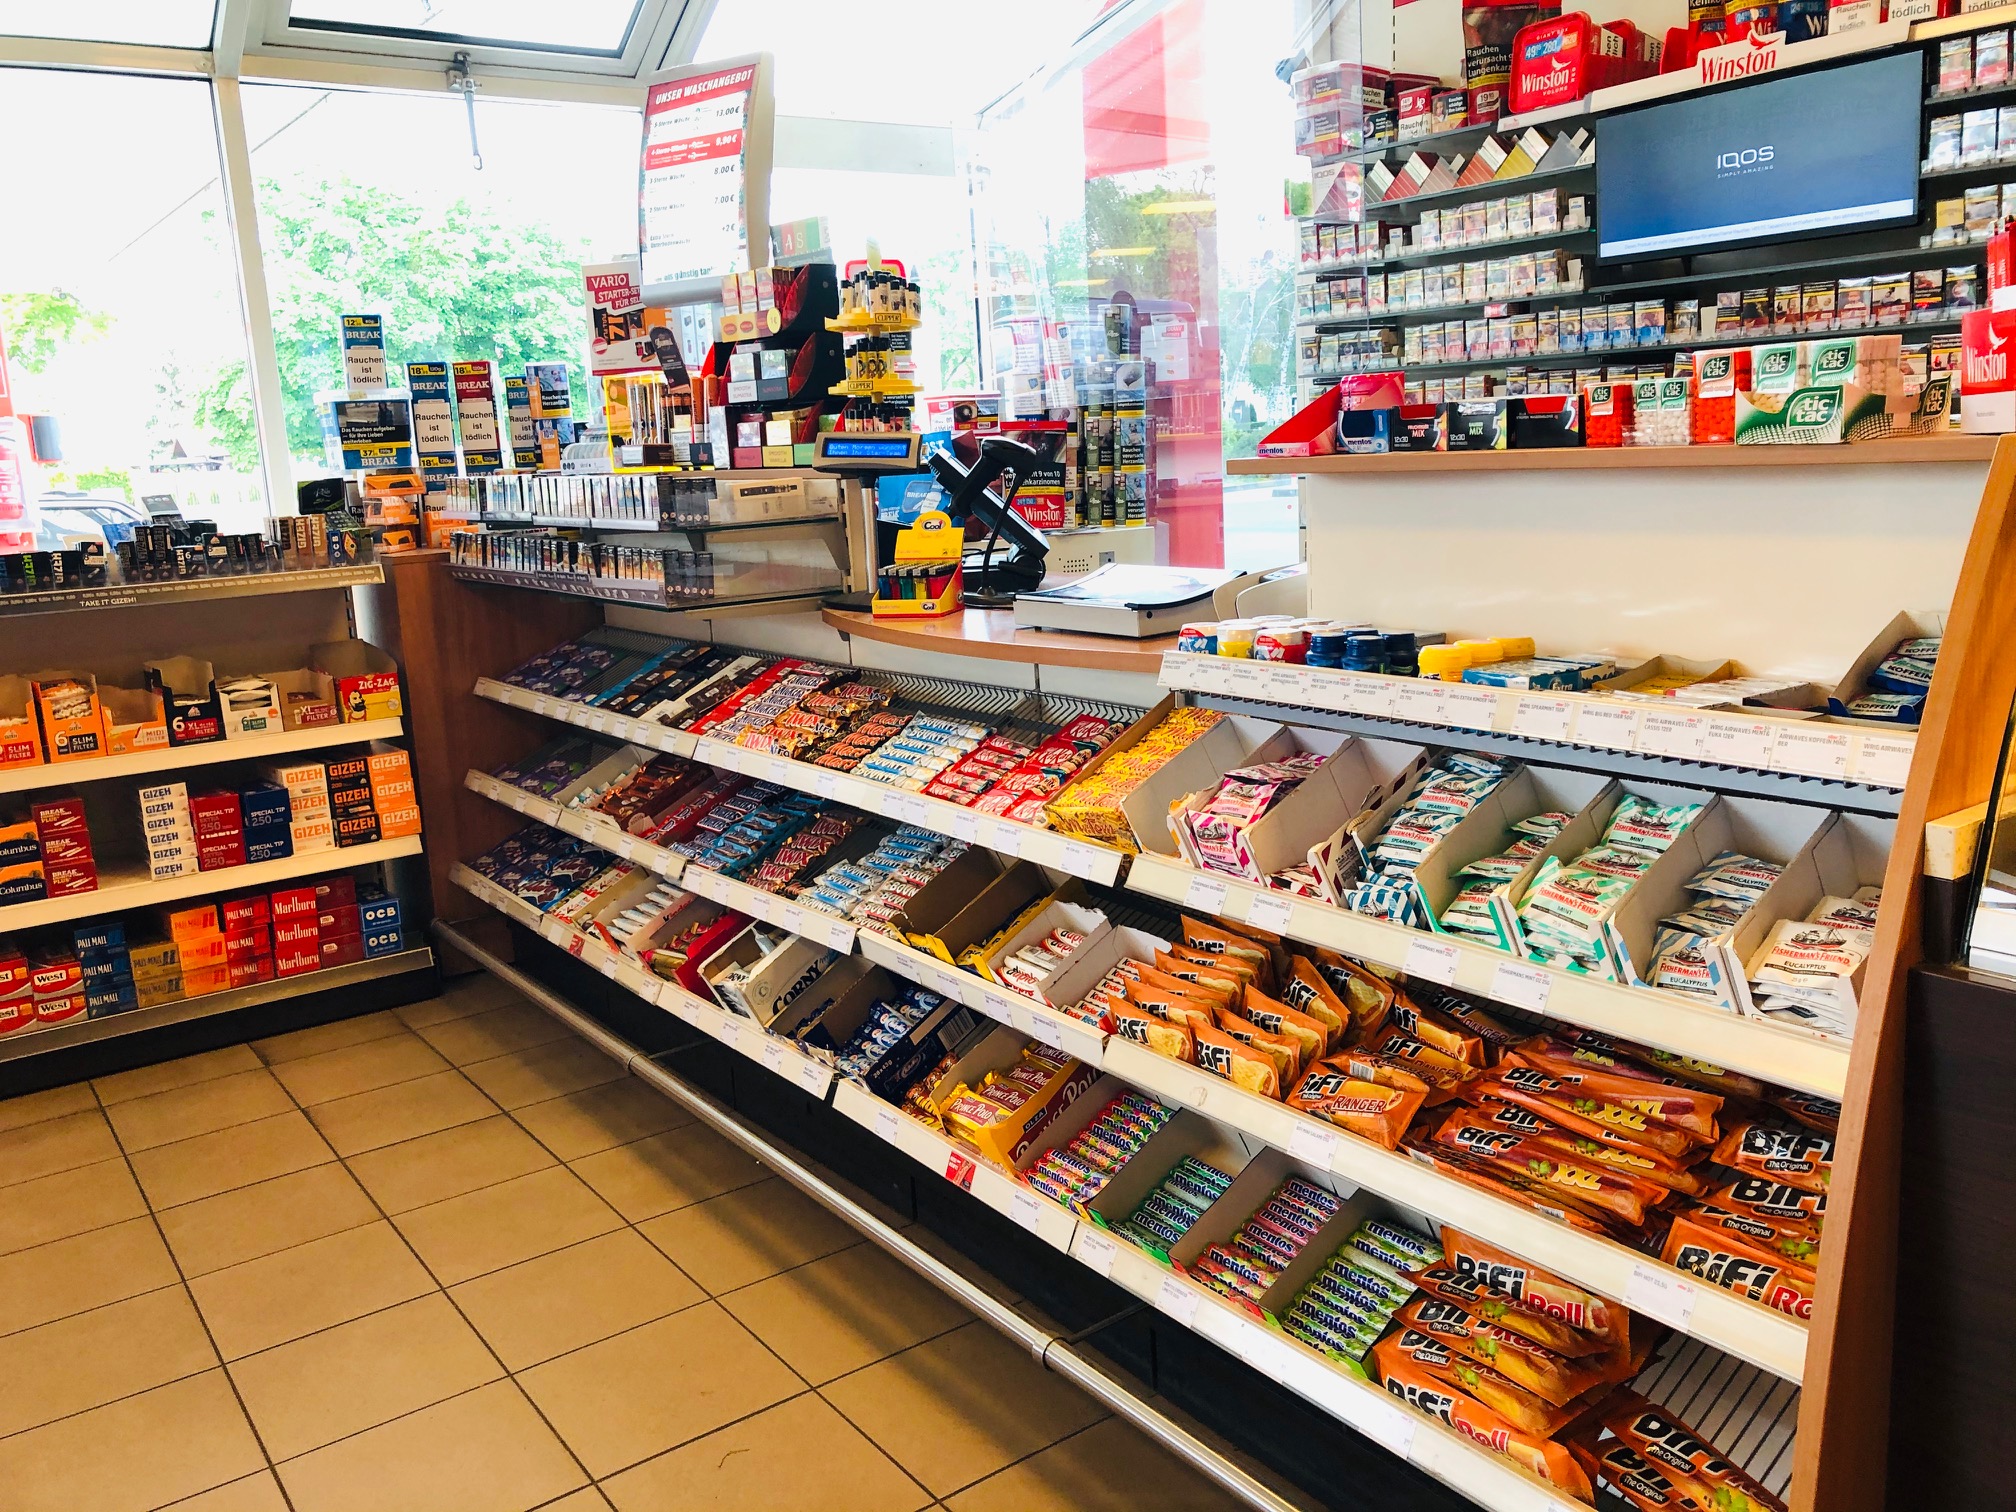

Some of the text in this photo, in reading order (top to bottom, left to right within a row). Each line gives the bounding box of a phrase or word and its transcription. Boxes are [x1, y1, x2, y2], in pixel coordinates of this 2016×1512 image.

[1891, 4, 1931, 19] tödlich
[1467, 45, 1500, 58] Rauchen
[1467, 54, 1508, 68] verursacht
[1700, 49, 1777, 85] Winston
[656, 69, 752, 105] UNSER WASCHANGEBOT
[1520, 69, 1571, 95] Winston
[1716, 145, 1776, 171] IQOS
[1716, 164, 1775, 179] SIMPLY AMAZING
[590, 274, 628, 289] VARIO
[614, 297, 629, 310] FÜR
[876, 314, 900, 322] CLIPPER
[346, 330, 381, 340] BREAK
[347, 356, 384, 364] Rauchen
[1769, 352, 1788, 365] tic
[1827, 348, 1846, 360] tic
[361, 366, 372, 374] ist
[1711, 355, 1731, 370] tic
[1765, 361, 1786, 373] tac
[1822, 357, 1845, 369] tac
[1965, 345, 2008, 382] Winston
[1706, 364, 1730, 377] tac
[353, 374, 383, 384] tödlich
[412, 381, 448, 391] BREAK
[456, 380, 490, 390] BREAK
[849, 382, 872, 390] CLIPPER
[1803, 395, 1832, 412] tic
[415, 413, 451, 421] Rauchen
[459, 412, 494, 421] Rauchen
[1796, 409, 1830, 423] tac
[429, 424, 440, 432] ist
[472, 422, 483, 430] ist
[1411, 428, 1426, 439] MIX
[1468, 426, 1484, 437] MIX
[421, 434, 450, 443] tödlich
[465, 432, 492, 441] tödlich
[361, 456, 398, 467] BREAK
[923, 519, 944, 531] Cool
[79, 599, 101, 607] TAKE
[101, 598, 110, 606] IT
[358, 677, 396, 691] ZIG-ZAG
[1853, 703, 1899, 711] KOFFEIN
[172, 716, 186, 732] 6
[306, 712, 329, 722] FILTER
[920, 716, 958, 731] BOUNTY
[145, 729, 166, 738] MIDI
[1709, 724, 1724, 732] WRIG
[1724, 726, 1752, 735] AIRWAVES
[54, 730, 68, 746] 6
[72, 736, 94, 746] SLIM
[1778, 733, 1848, 747] AIRWAVES KOFFEIN MINZ
[7, 744, 30, 754] SLIM
[73, 742, 95, 751] FILTER
[1863, 742, 1913, 755] WRIG AIRWAVES
[328, 760, 366, 778] GIZEH
[371, 753, 408, 770] GIZEH
[285, 767, 324, 785] GIZEH
[333, 787, 371, 804] GIZEH
[376, 780, 413, 797] GIZEH
[198, 807, 235, 818] SPECIAL TIP
[250, 806, 286, 818] SPECIAL TIP
[1425, 802, 1452, 812] SPEARMINT
[251, 814, 272, 826] 250
[338, 815, 377, 833] GIZEH
[293, 821, 332, 840] GIZEH
[812, 820, 843, 837] TWIX
[249, 840, 285, 852] SPECIAL TIP
[1391, 837, 1417, 847] SPEARMINT
[1629, 834, 1645, 843] MINT
[250, 849, 271, 860] 250
[775, 848, 808, 867] TWIX
[757, 863, 792, 882] TWIX
[839, 863, 873, 881] BOUNTY
[0, 881, 43, 896] Columbus
[1729, 875, 1770, 888] EUCALYPTUS
[274, 899, 317, 918] Marlboro
[365, 906, 397, 922] OCB
[1556, 904, 1574, 917] MINT
[76, 934, 107, 950] PALL MALL
[275, 926, 318, 946] Marlboro
[368, 933, 398, 949] OCB
[277, 952, 320, 972] Marlboro
[1771, 945, 1851, 966] FISHERMAN'S FRIEND
[1783, 959, 1827, 972] EUCALYPTUS
[34, 969, 65, 986] West
[1669, 976, 1708, 988] EUCALYPTUS
[772, 957, 822, 1017] CORNY
[39, 1000, 69, 1015] West
[1197, 1040, 1233, 1076] BiFi
[1298, 1073, 1349, 1094] BiFi
[983, 1085, 1026, 1107] PRINCE POLO
[1333, 1094, 1387, 1113] RANGER
[950, 1098, 993, 1120] PRINCE POLO
[1024, 1109, 1045, 1134] OLZA
[1596, 1103, 1648, 1132] XXL
[1456, 1125, 1524, 1151] BiFi
[1766, 1160, 1811, 1171] The Original
[1551, 1163, 1602, 1191] XXL
[1269, 1201, 1316, 1230] mentos
[1135, 1212, 1181, 1244] mentos
[1726, 1219, 1772, 1238] The Original
[1367, 1221, 1427, 1256] mentos
[1210, 1250, 1260, 1284] mentos
[1674, 1244, 1781, 1301] BiFi
[1333, 1261, 1390, 1299] mentos
[1528, 1292, 1585, 1329] Roll
[1456, 1418, 1509, 1453] Roll
[1651, 1445, 1690, 1472] The Original
[1623, 1475, 1665, 1503] The Original
